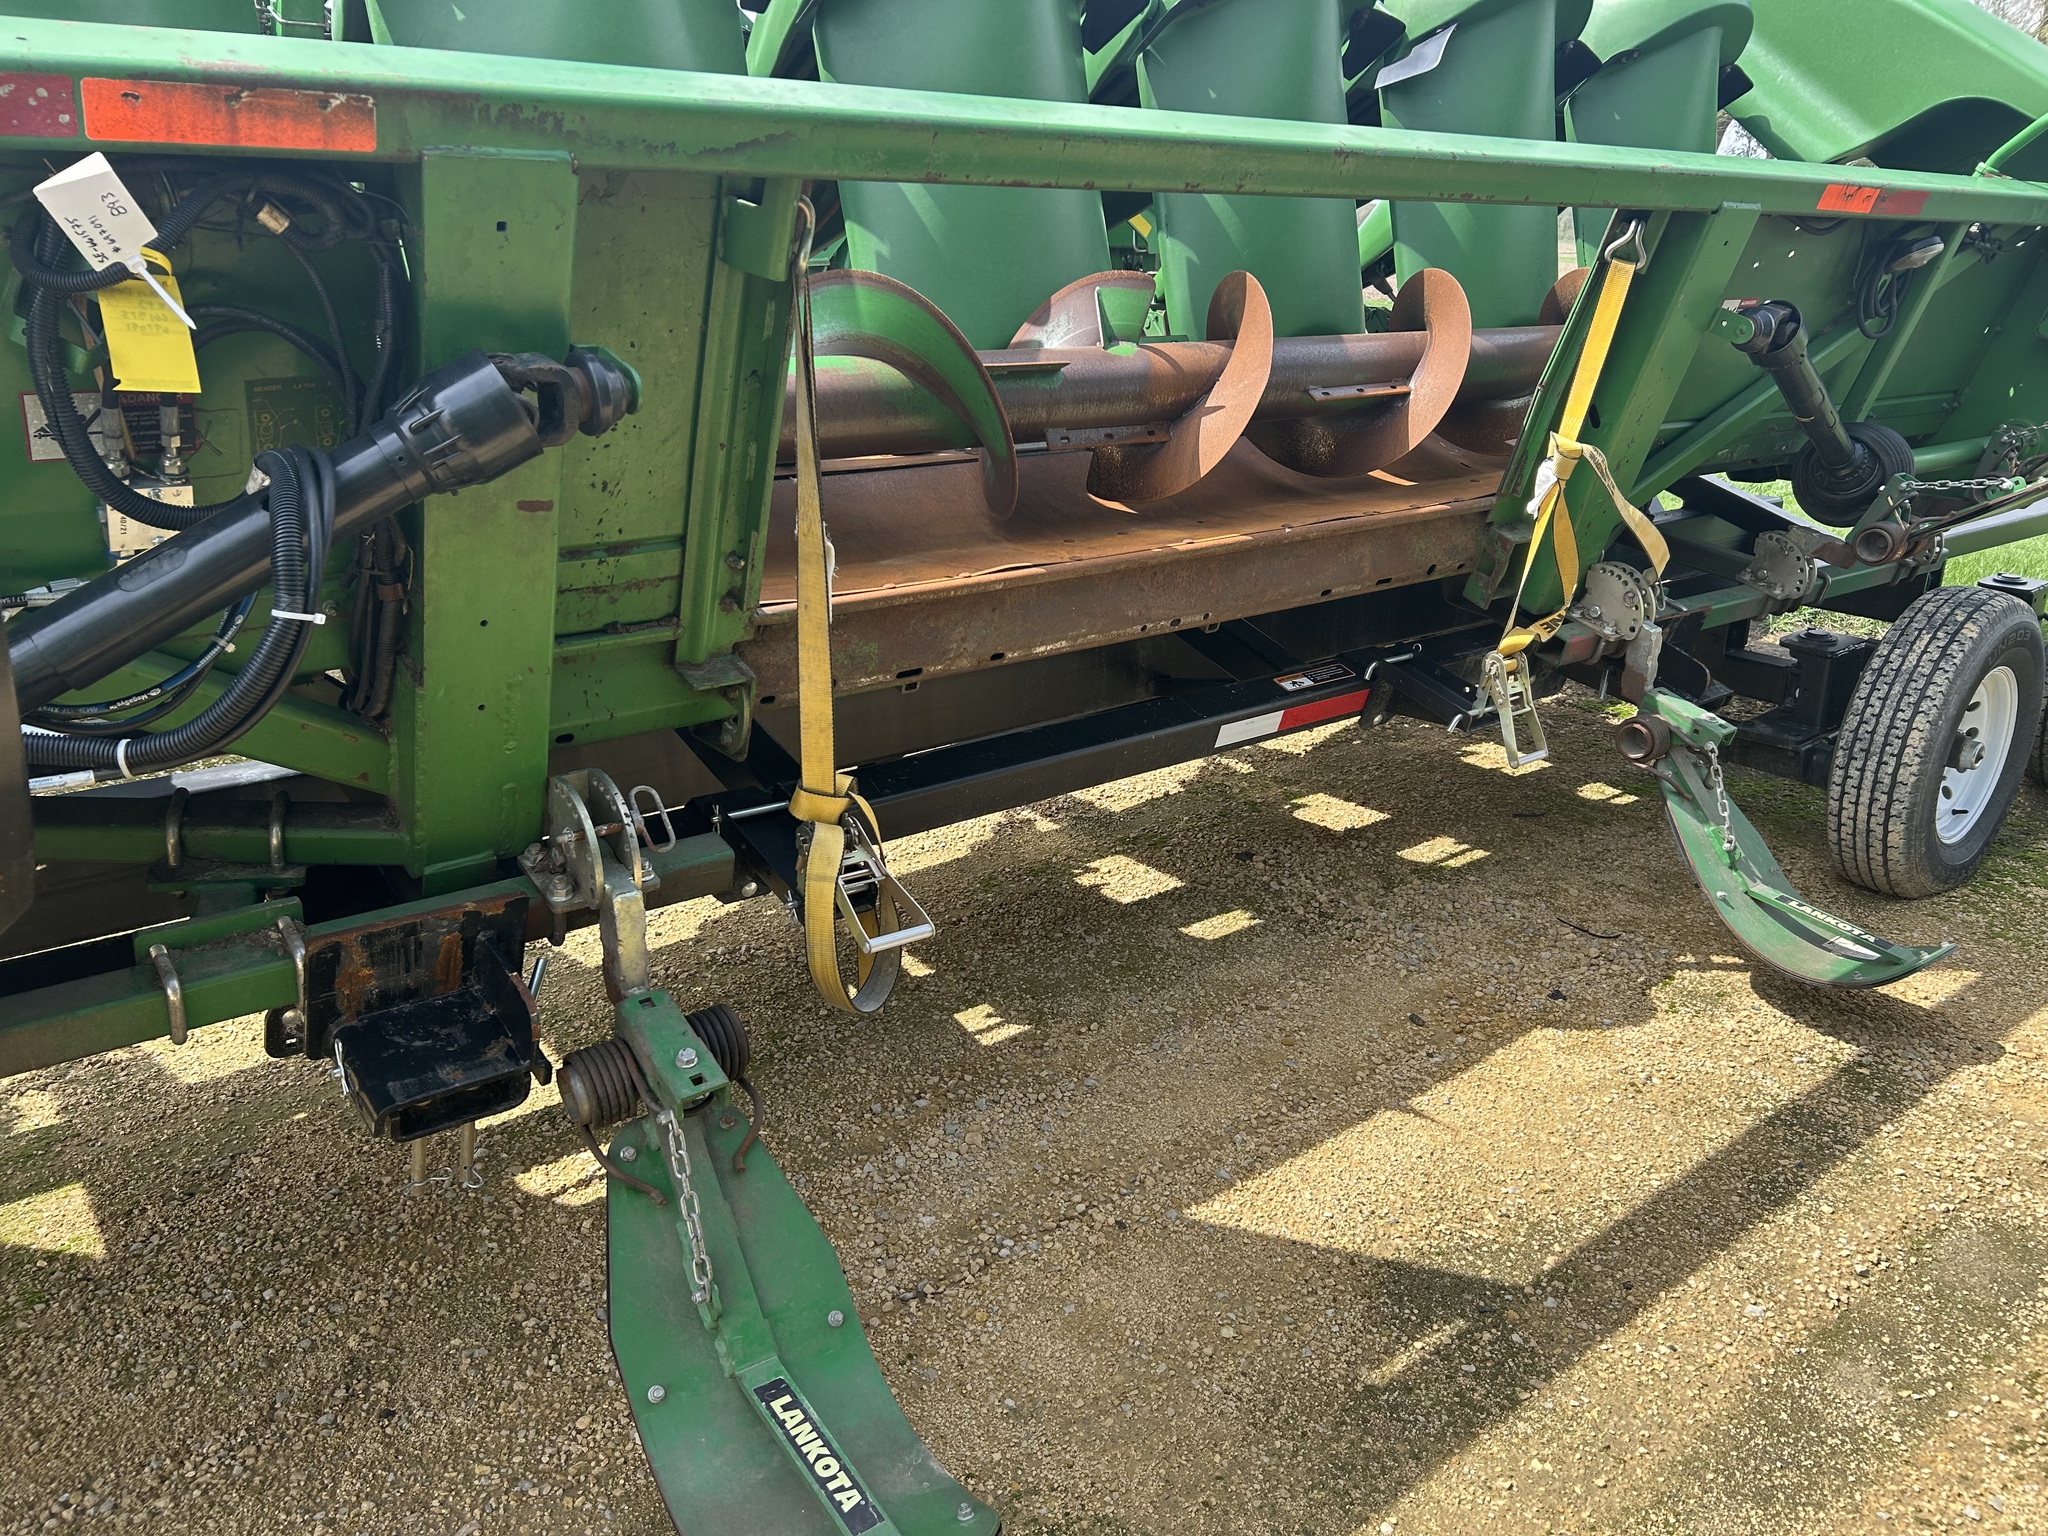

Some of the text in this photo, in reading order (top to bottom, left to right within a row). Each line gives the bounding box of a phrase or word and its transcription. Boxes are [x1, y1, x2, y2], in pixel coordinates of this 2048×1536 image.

[100, 191, 128, 217] 893
[127, 392, 183, 403] DANGR
[254, 384, 282, 392] HEADER
[119, 516, 128, 535] 40/21
[1789, 901, 1876, 943] LANKOTA
[769, 1394, 862, 1514] LANKOTA
